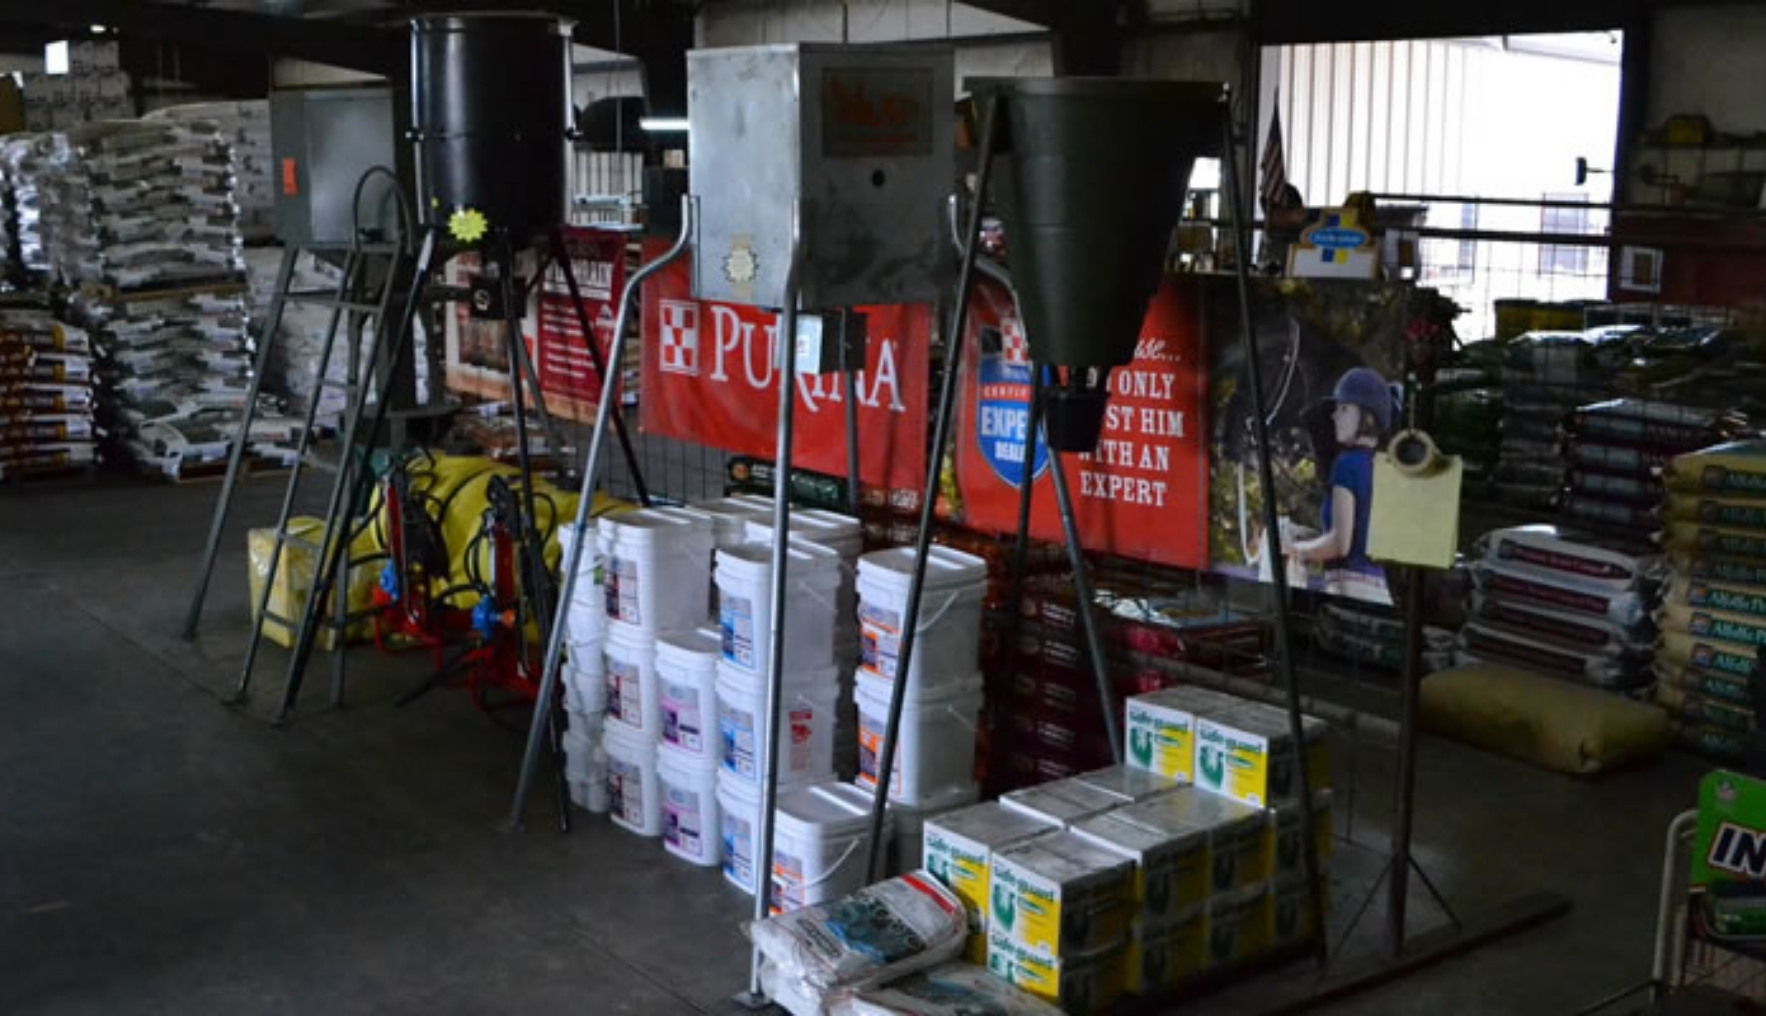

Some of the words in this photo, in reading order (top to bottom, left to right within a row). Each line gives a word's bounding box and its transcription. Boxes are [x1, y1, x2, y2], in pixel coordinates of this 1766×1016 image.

[710, 304, 906, 412] PUA
[1118, 369, 1176, 400] ONLY
[981, 405, 1029, 440] EXPE
[1140, 408, 1184, 438] HIM
[1078, 439, 1134, 468] ITH
[1138, 443, 1171, 472] AN
[1080, 469, 1168, 507] EXPERT
